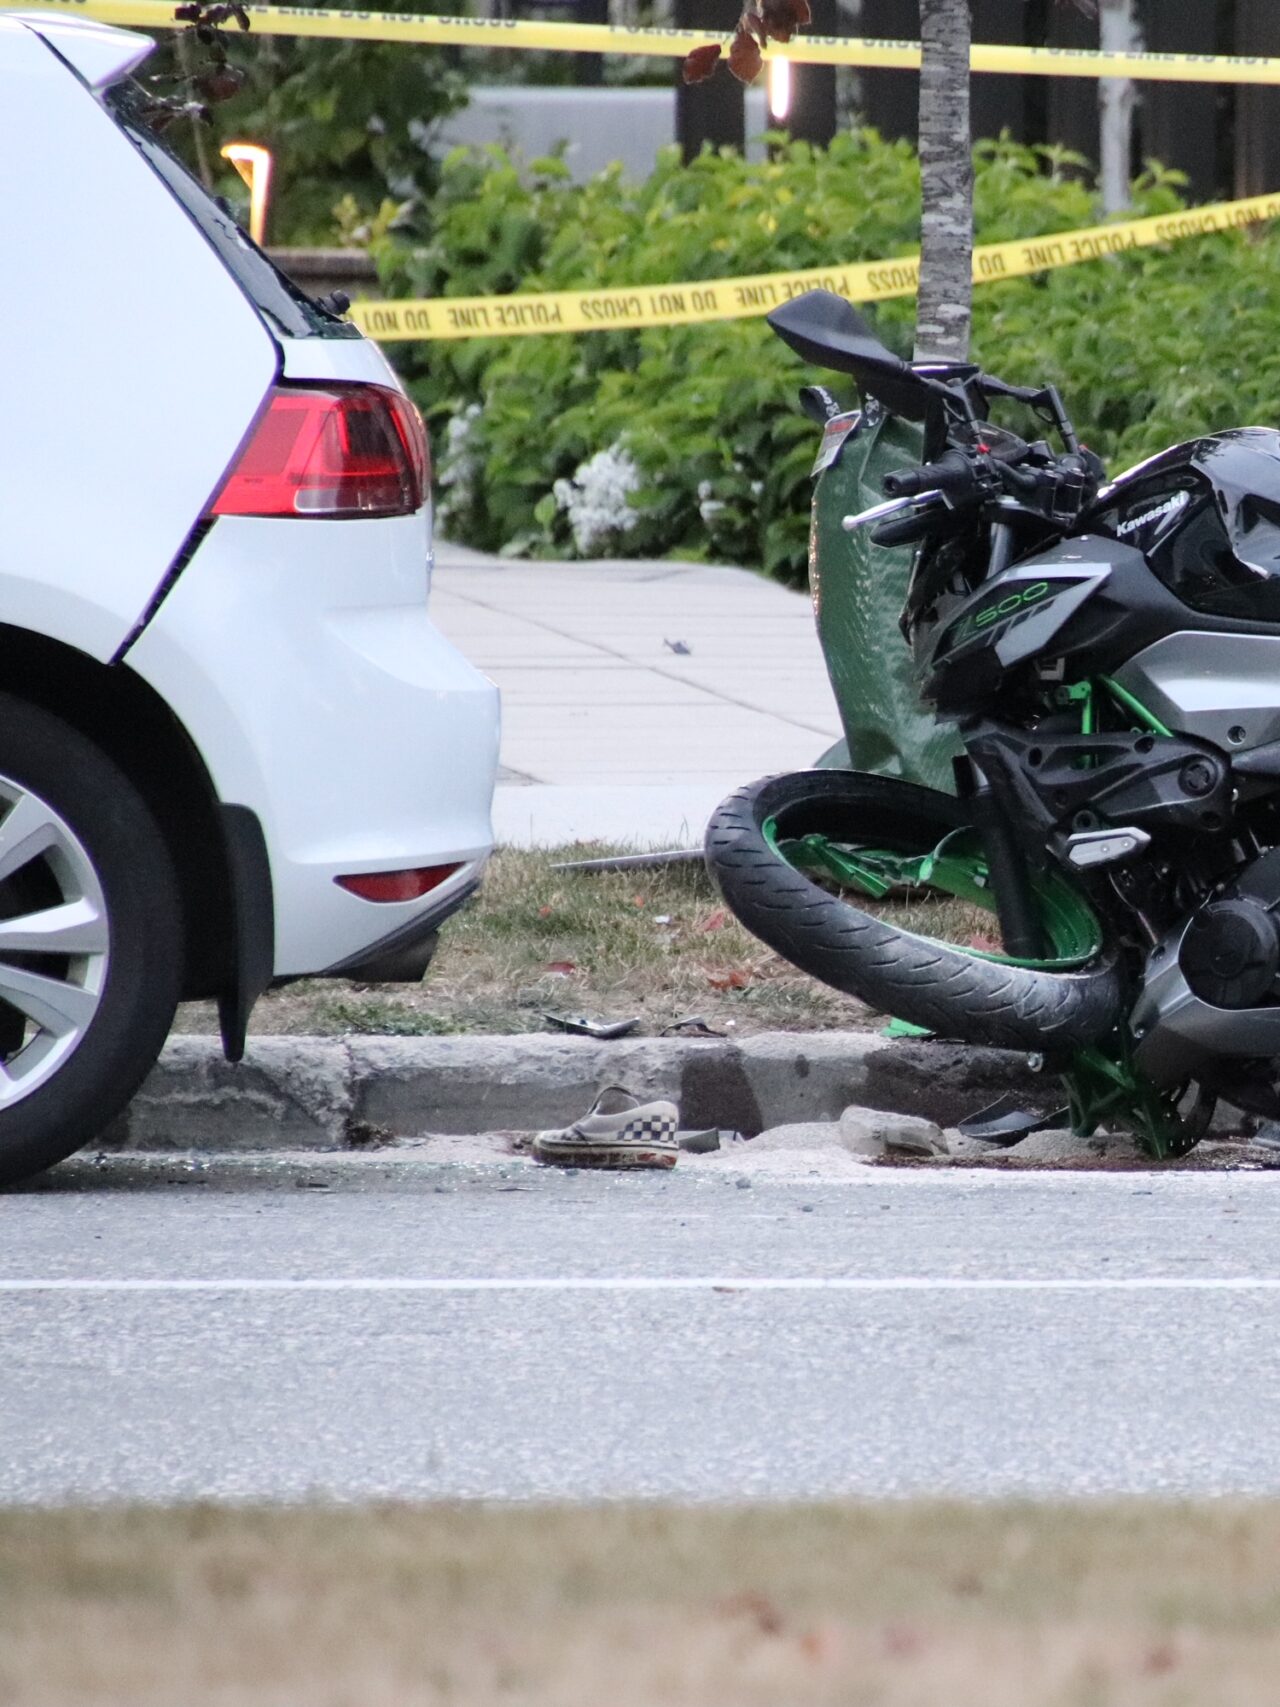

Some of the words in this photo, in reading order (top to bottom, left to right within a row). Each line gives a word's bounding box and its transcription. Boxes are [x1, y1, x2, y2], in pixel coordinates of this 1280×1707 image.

[978, 253, 1006, 275] DO
[1023, 242, 1067, 268] LINE
[650, 293, 686, 316] NOT
[690, 288, 718, 312] DO
[734, 283, 778, 308] LINE
[363, 309, 399, 331] NOT
[404, 309, 431, 330] DO
[447, 305, 491, 328] LINE
[495, 302, 563, 327] POLICE
[579, 296, 643, 320] CROSS
[1116, 490, 1187, 538] Kawasaki
